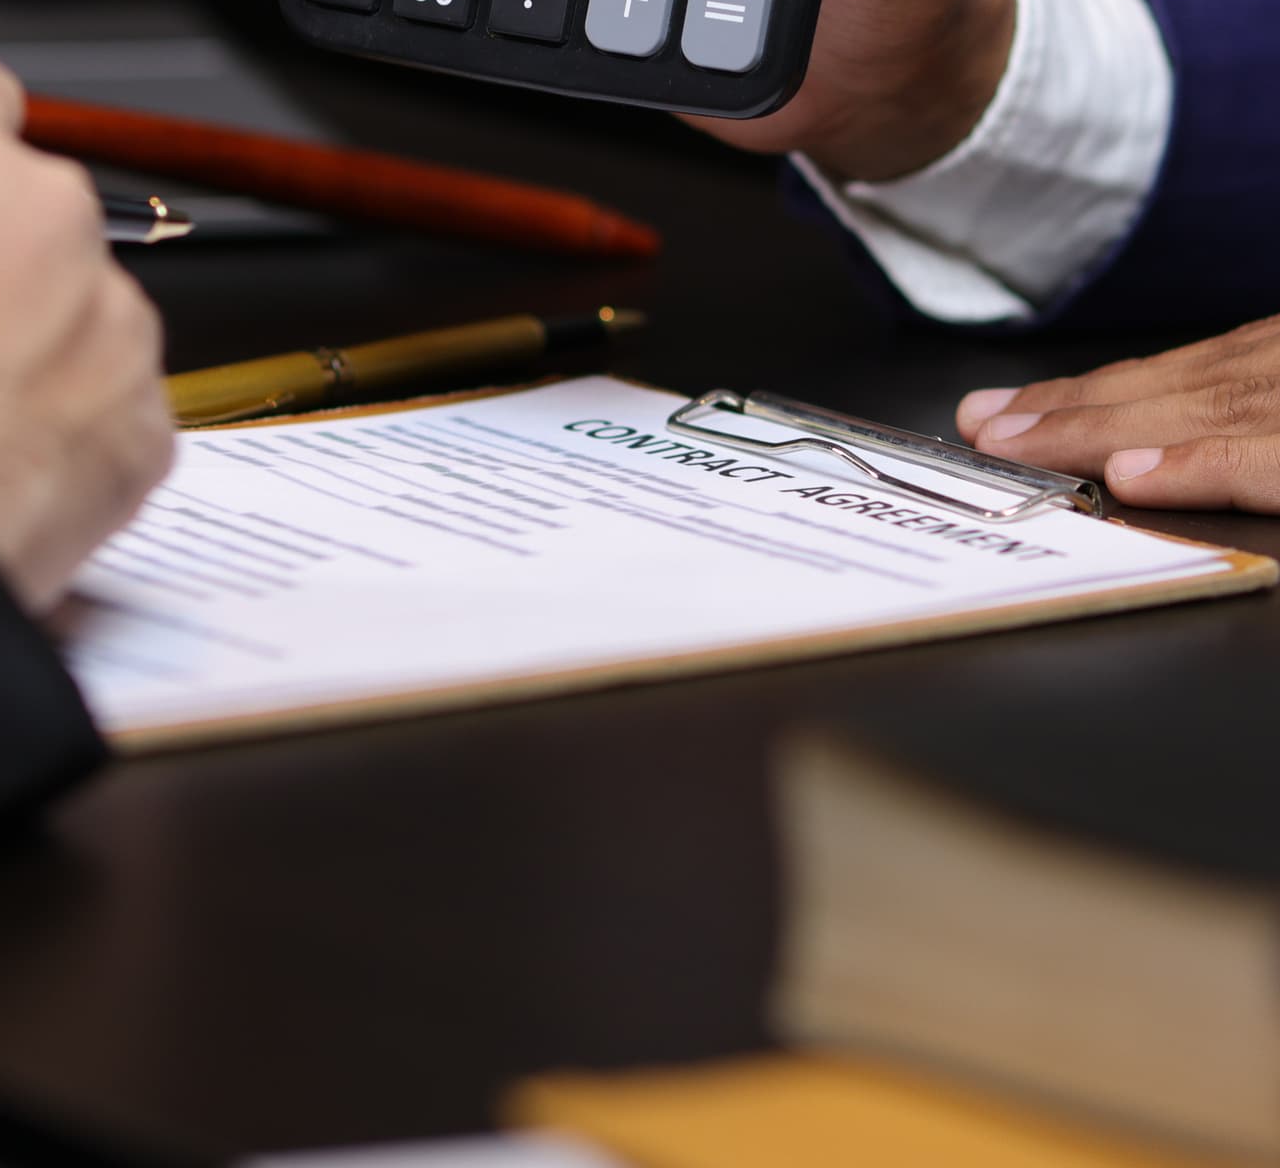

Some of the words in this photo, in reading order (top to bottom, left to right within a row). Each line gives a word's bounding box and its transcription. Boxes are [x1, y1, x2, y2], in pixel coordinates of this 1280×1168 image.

[705, 1, 745, 22] =
[563, 419, 795, 482] CONTRACT
[779, 485, 1068, 561] AGREEMENT
